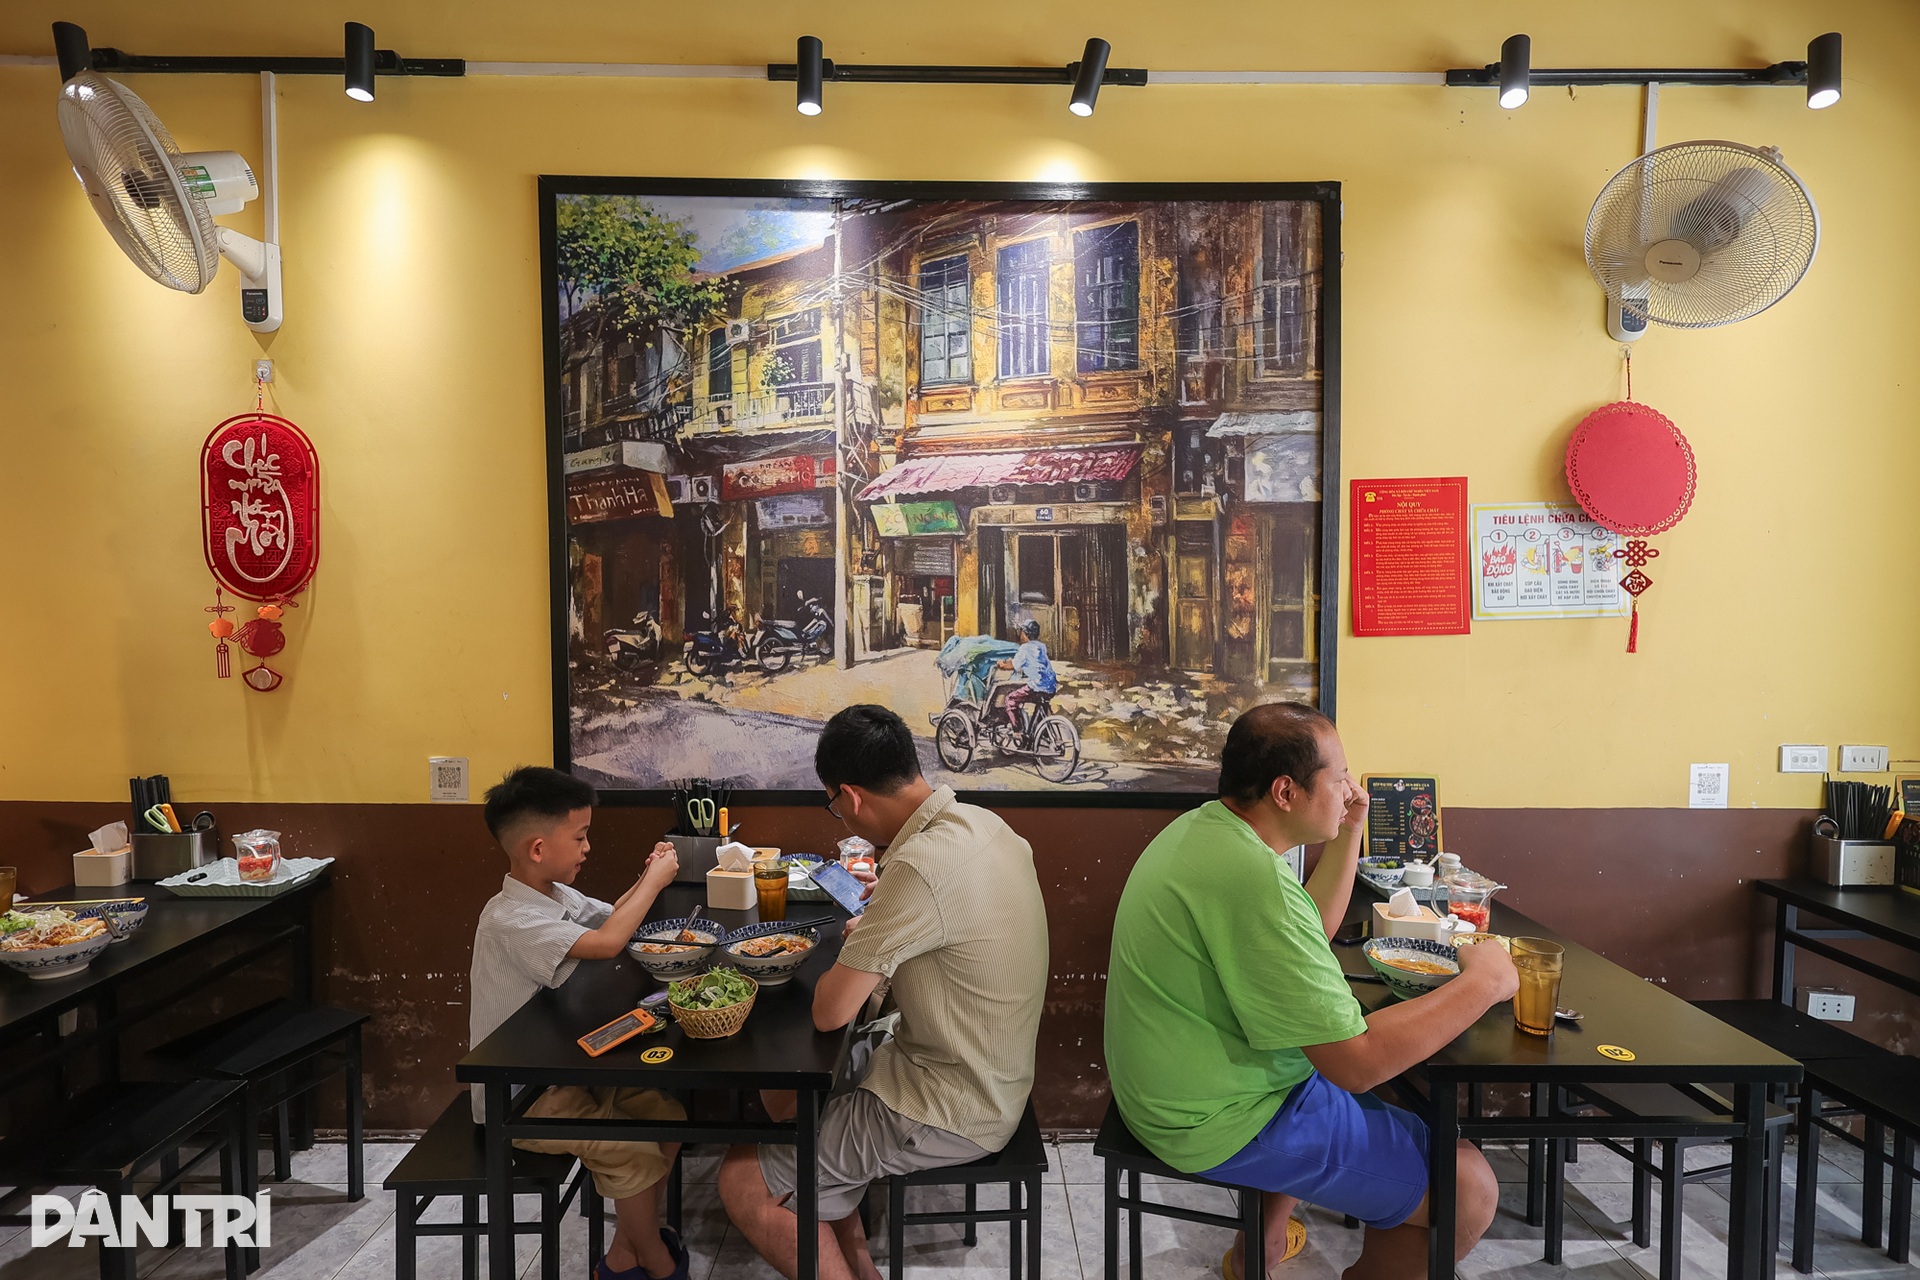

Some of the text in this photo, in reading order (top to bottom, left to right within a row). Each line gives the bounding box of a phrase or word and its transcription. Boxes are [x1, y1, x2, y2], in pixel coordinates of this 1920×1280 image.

[1493, 514, 1515, 525] TIÊU
[1518, 514, 1544, 526] LỆNH
[1496, 532, 1501, 540] 1
[1530, 531, 1536, 539] 2
[1563, 530, 1570, 538] 3
[1604, 1048, 1629, 1057] 02
